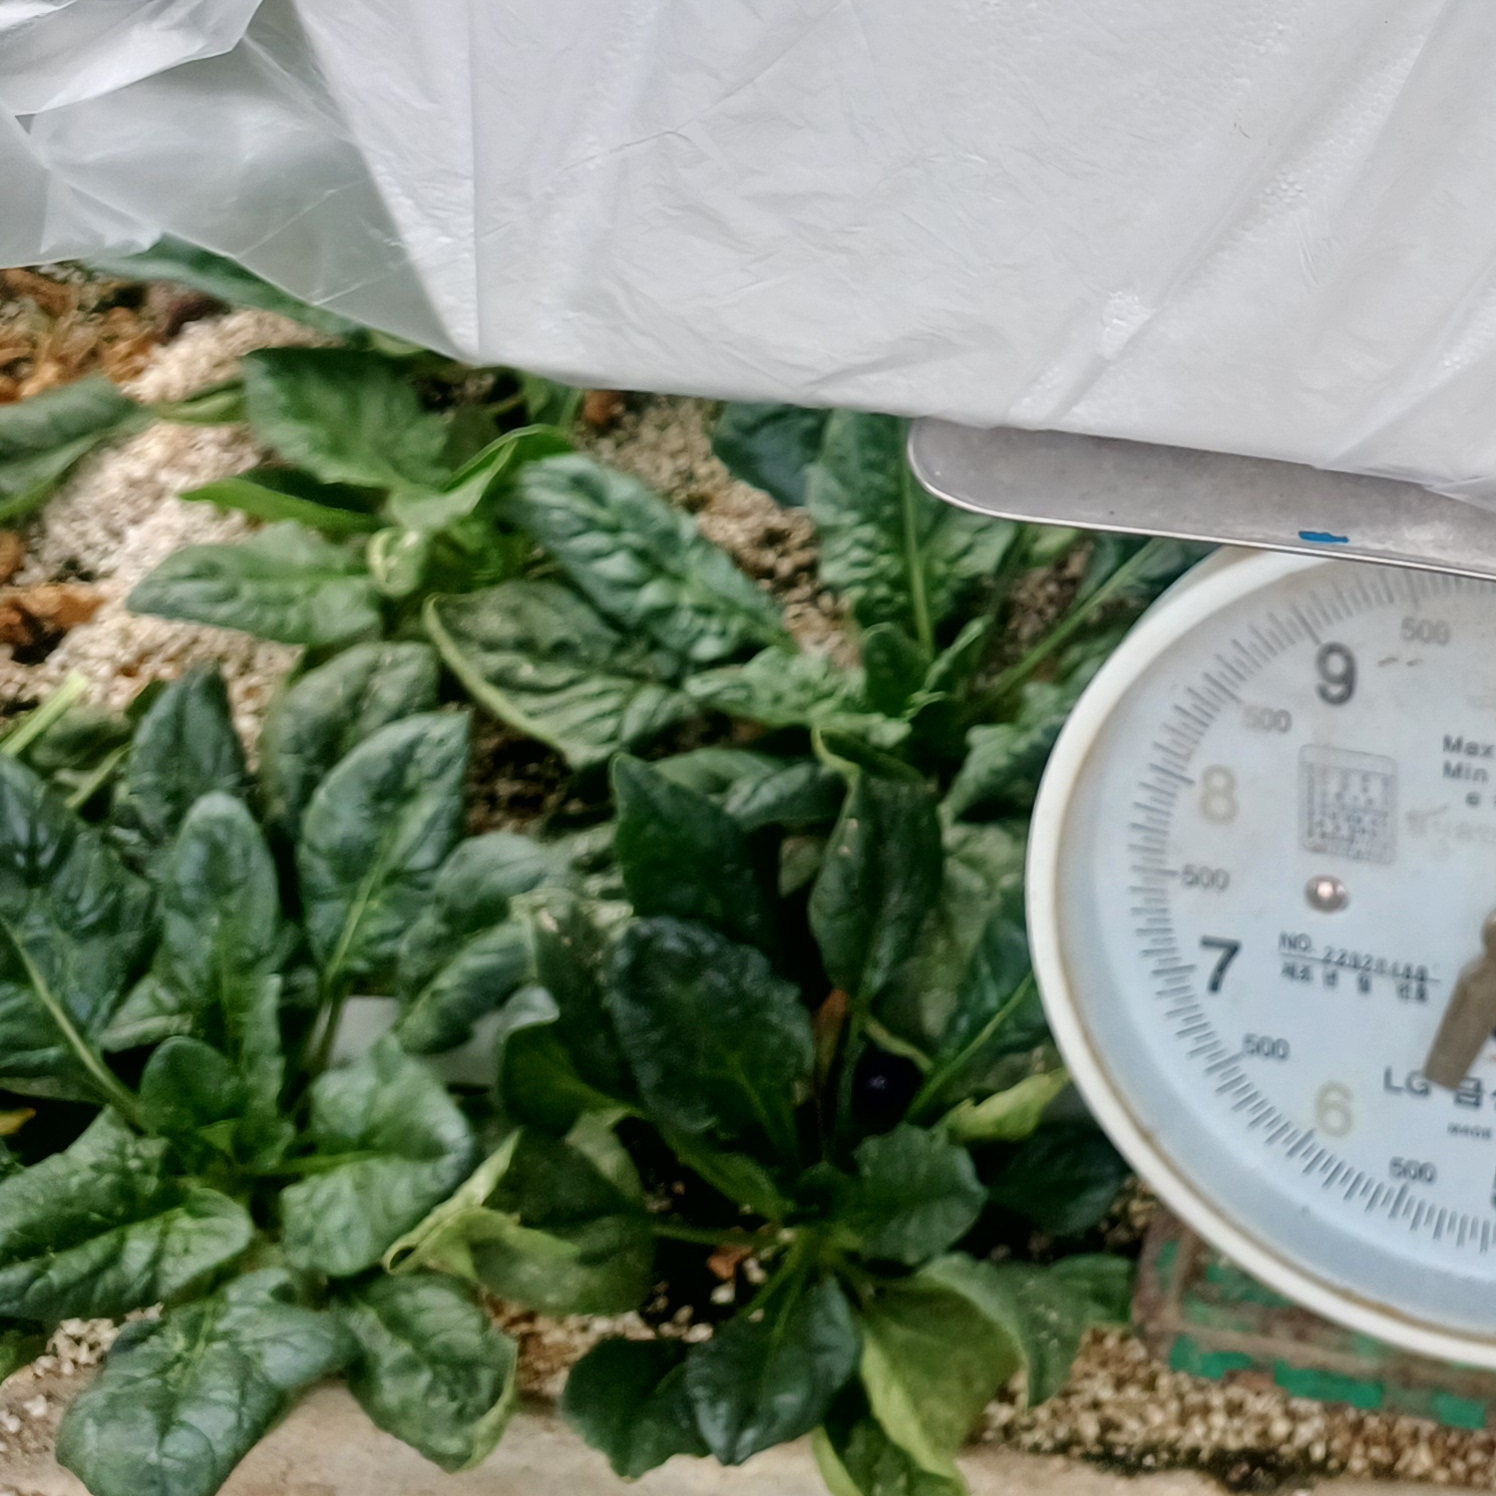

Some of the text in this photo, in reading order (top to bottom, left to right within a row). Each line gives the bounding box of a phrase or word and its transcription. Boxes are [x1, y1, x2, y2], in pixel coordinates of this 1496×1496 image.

[1401, 616, 1450, 646] 500
[1315, 640, 1358, 707] 9
[1442, 734, 1494, 759] Max
[1442, 759, 1488, 783] Min
[1201, 763, 1239, 825] 8
[1181, 863, 1231, 892] 500
[1199, 933, 1242, 994] 7
[1242, 1033, 1290, 1061] 500
[1383, 1064, 1432, 1098] LG
[1315, 1079, 1354, 1138] 6
[1388, 1155, 1437, 1184] 500
